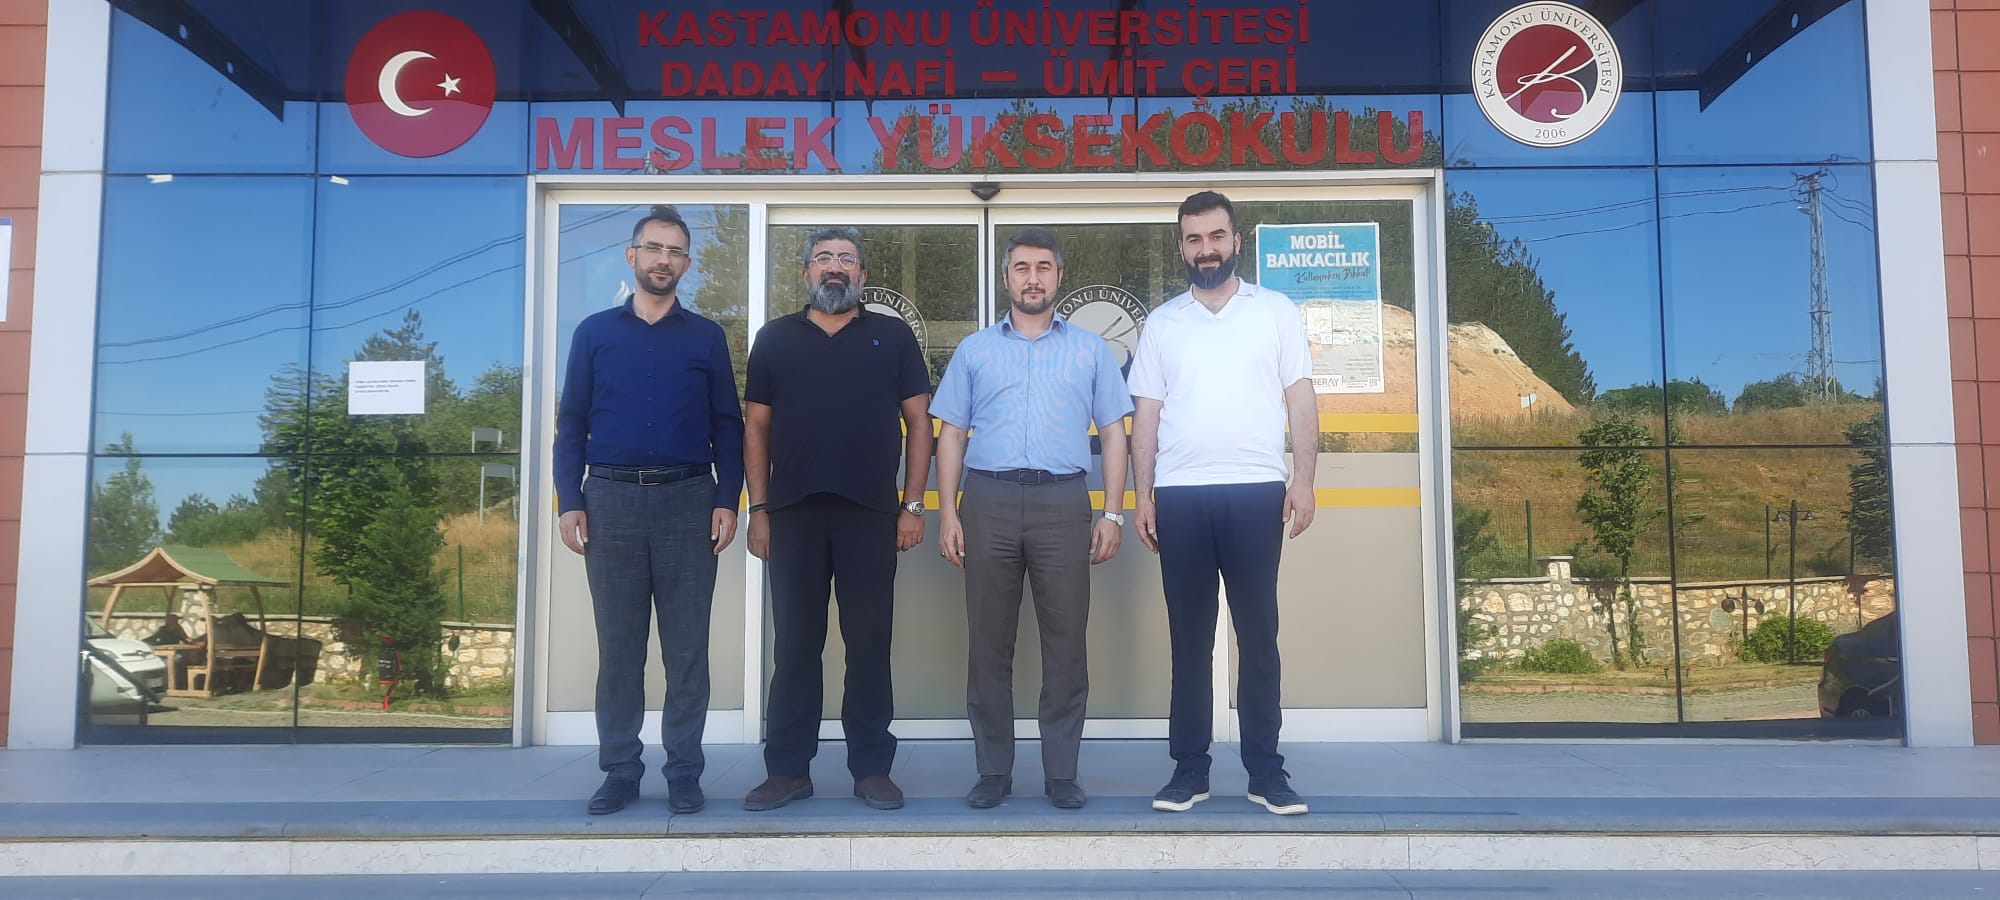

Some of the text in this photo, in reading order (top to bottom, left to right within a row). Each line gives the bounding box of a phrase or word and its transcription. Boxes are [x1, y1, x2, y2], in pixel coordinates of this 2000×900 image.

[638, 0, 1309, 47] KASTAMONU ÜNİVERSİTESİ
[661, 60, 827, 97] DADAY
[844, 48, 956, 97] NAFİ
[1043, 48, 1166, 96] ÜMİT
[1181, 46, 1298, 105] ÇERİ
[1481, 8, 1613, 99] KASTAMONU ÜNİVERSİTESİ
[535, 103, 1424, 171] MESLEK YÜKSEKOKULU
[1534, 128, 1567, 139] 2006
[1266, 252, 1370, 269] BANKACILIK
[1290, 231, 1345, 250] MOBİL
